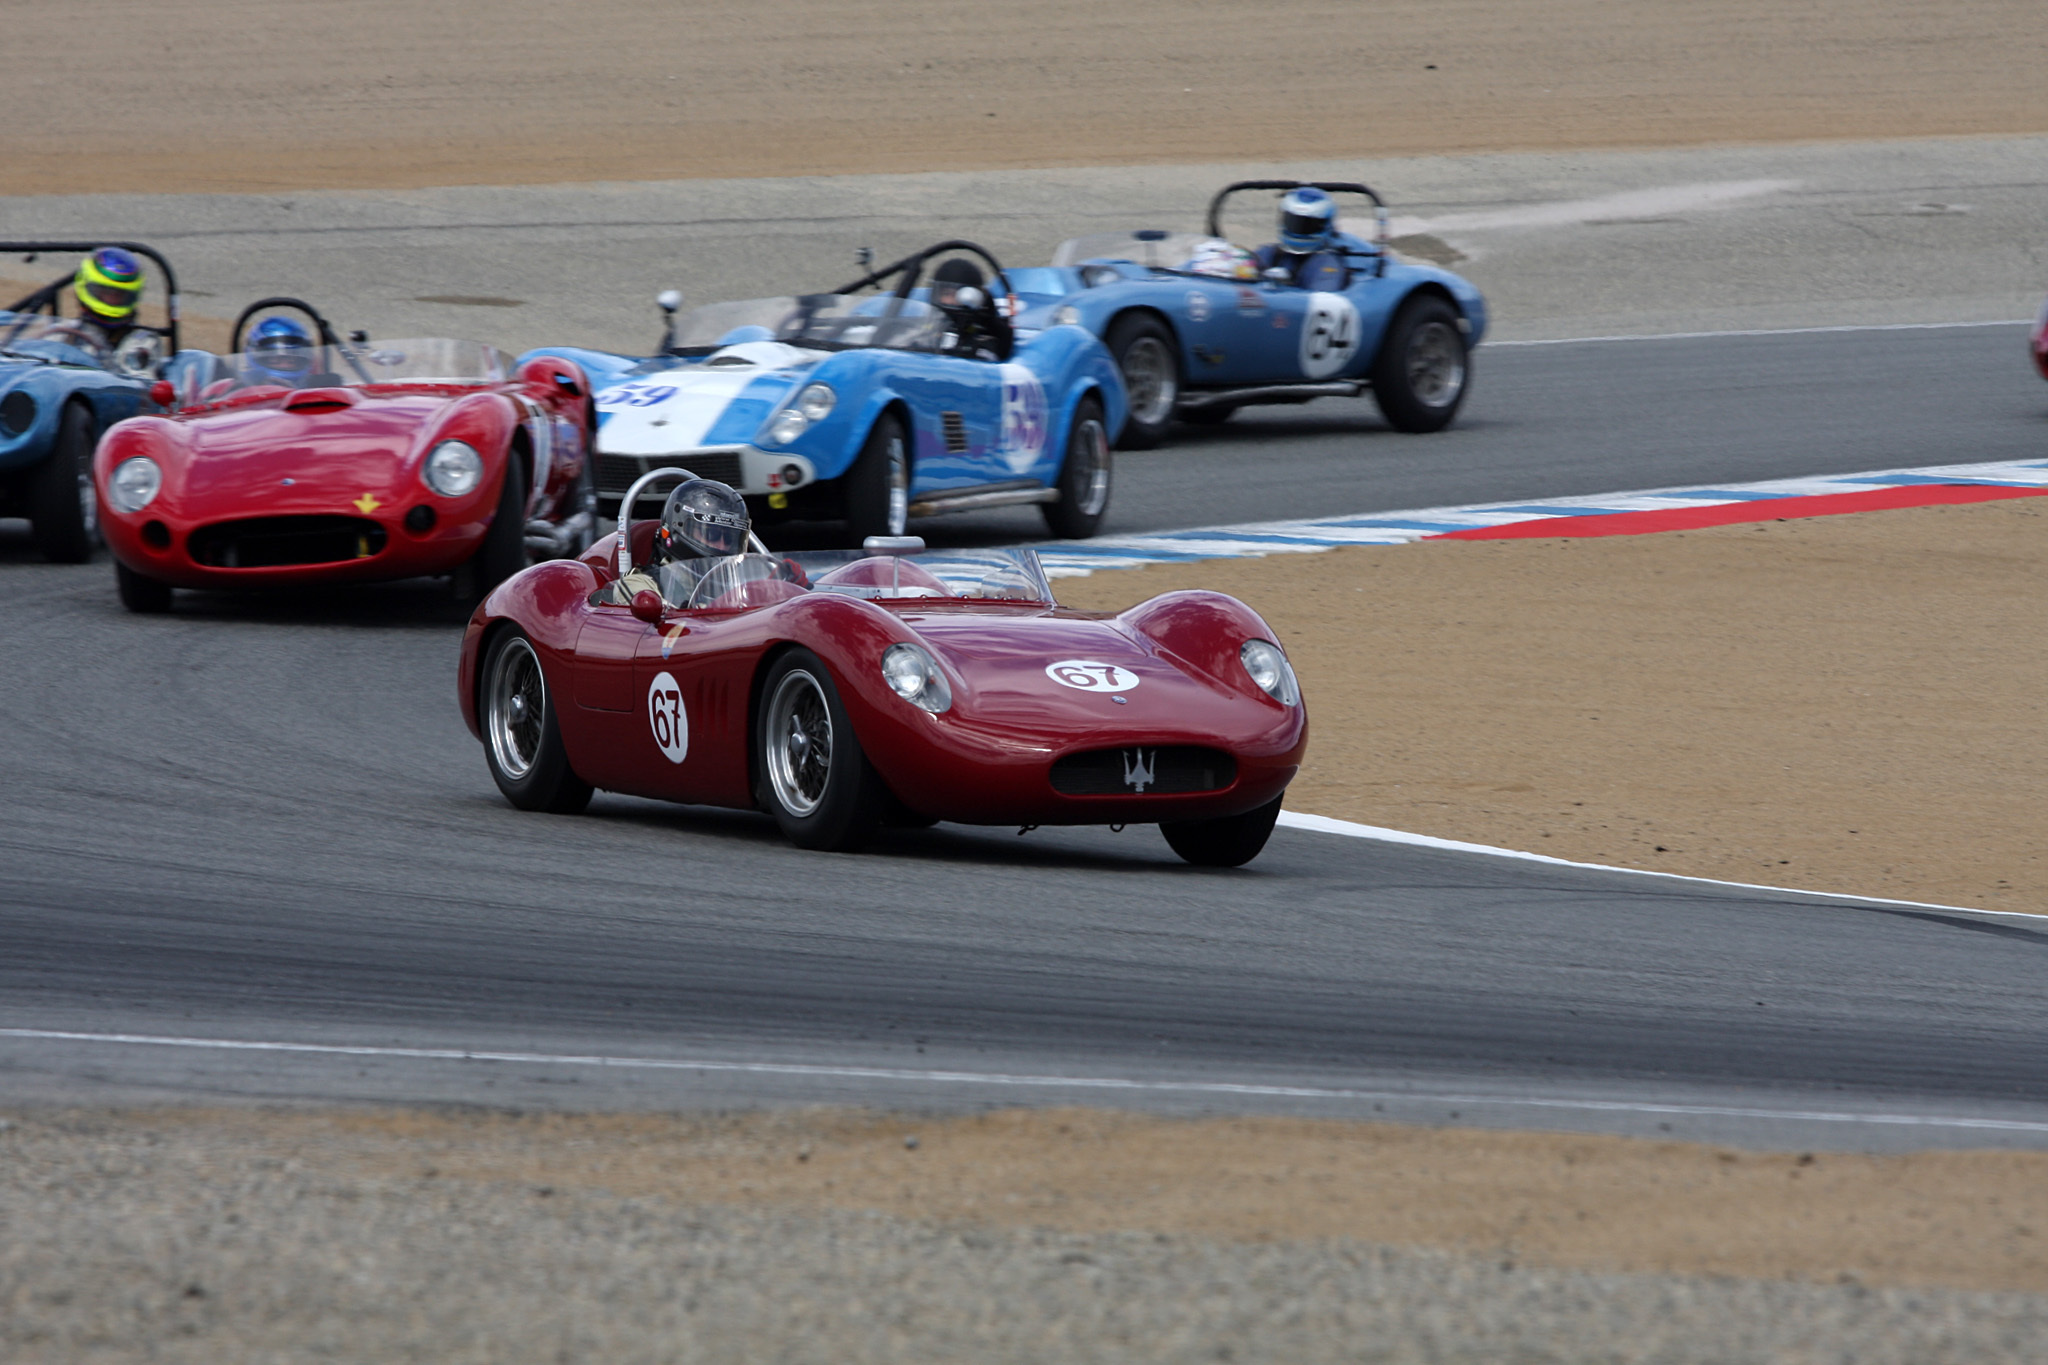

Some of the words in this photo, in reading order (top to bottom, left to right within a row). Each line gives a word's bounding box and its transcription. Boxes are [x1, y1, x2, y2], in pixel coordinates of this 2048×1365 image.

[1307, 309, 1353, 360] 64
[595, 384, 678, 407] 59
[1054, 666, 1119, 687] 67
[652, 689, 681, 749] 67
